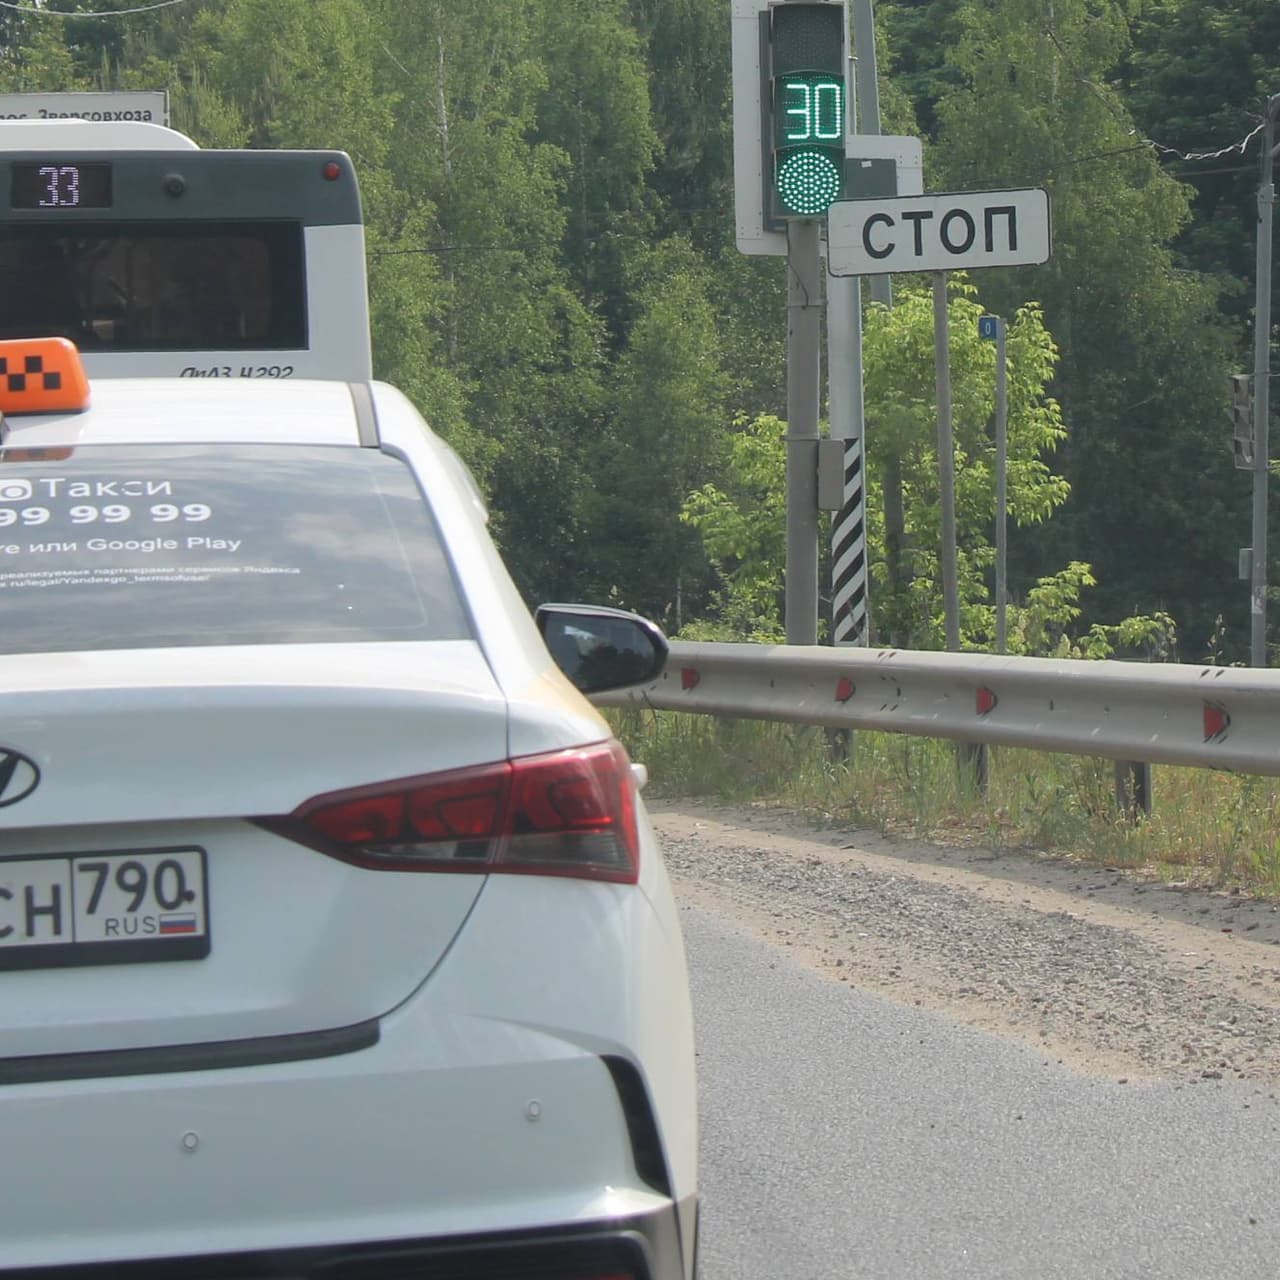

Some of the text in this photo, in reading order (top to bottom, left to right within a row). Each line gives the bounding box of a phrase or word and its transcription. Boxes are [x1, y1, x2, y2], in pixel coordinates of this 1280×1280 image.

[786, 84, 841, 139] 30
[39, 166, 80, 207] 33
[861, 206, 1017, 259] СТОП
[40, 478, 172, 497] Такси
[69, 505, 131, 524] 99
[150, 504, 211, 522] 99
[29, 542, 77, 554] или
[87, 538, 177, 553] Google
[187, 537, 242, 553] Play
[77, 858, 187, 916] 790
[105, 916, 157, 936] RUS
